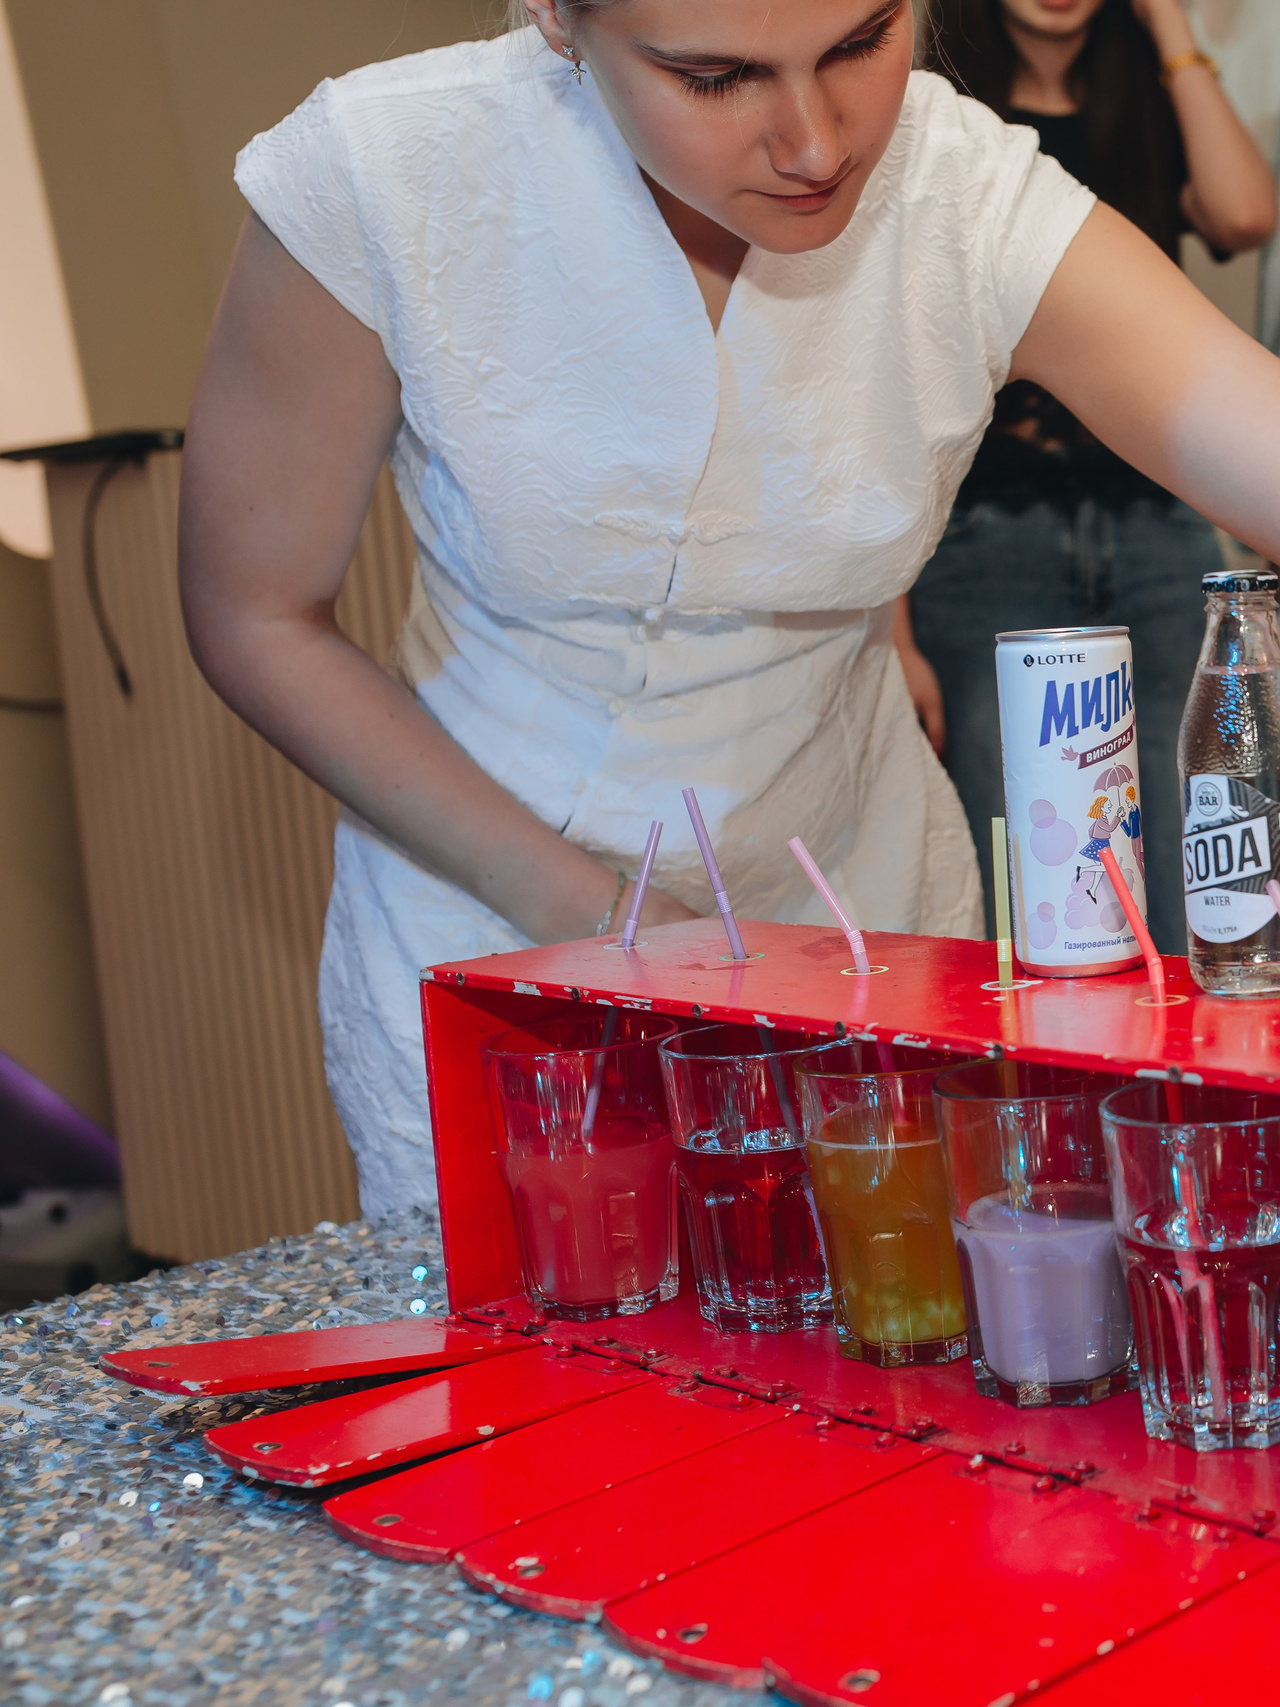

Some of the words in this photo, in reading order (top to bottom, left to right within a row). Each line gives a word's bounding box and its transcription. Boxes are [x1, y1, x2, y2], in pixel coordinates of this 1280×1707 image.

[1038, 653, 1086, 665] LOTTE
[1039, 660, 1135, 747] Милк
[1086, 731, 1131, 763] ВИНОГРАД
[1198, 796, 1219, 806] BAR
[1185, 827, 1262, 885] SODA
[1203, 896, 1231, 906] WATER
[1064, 935, 1122, 951] Газированный
